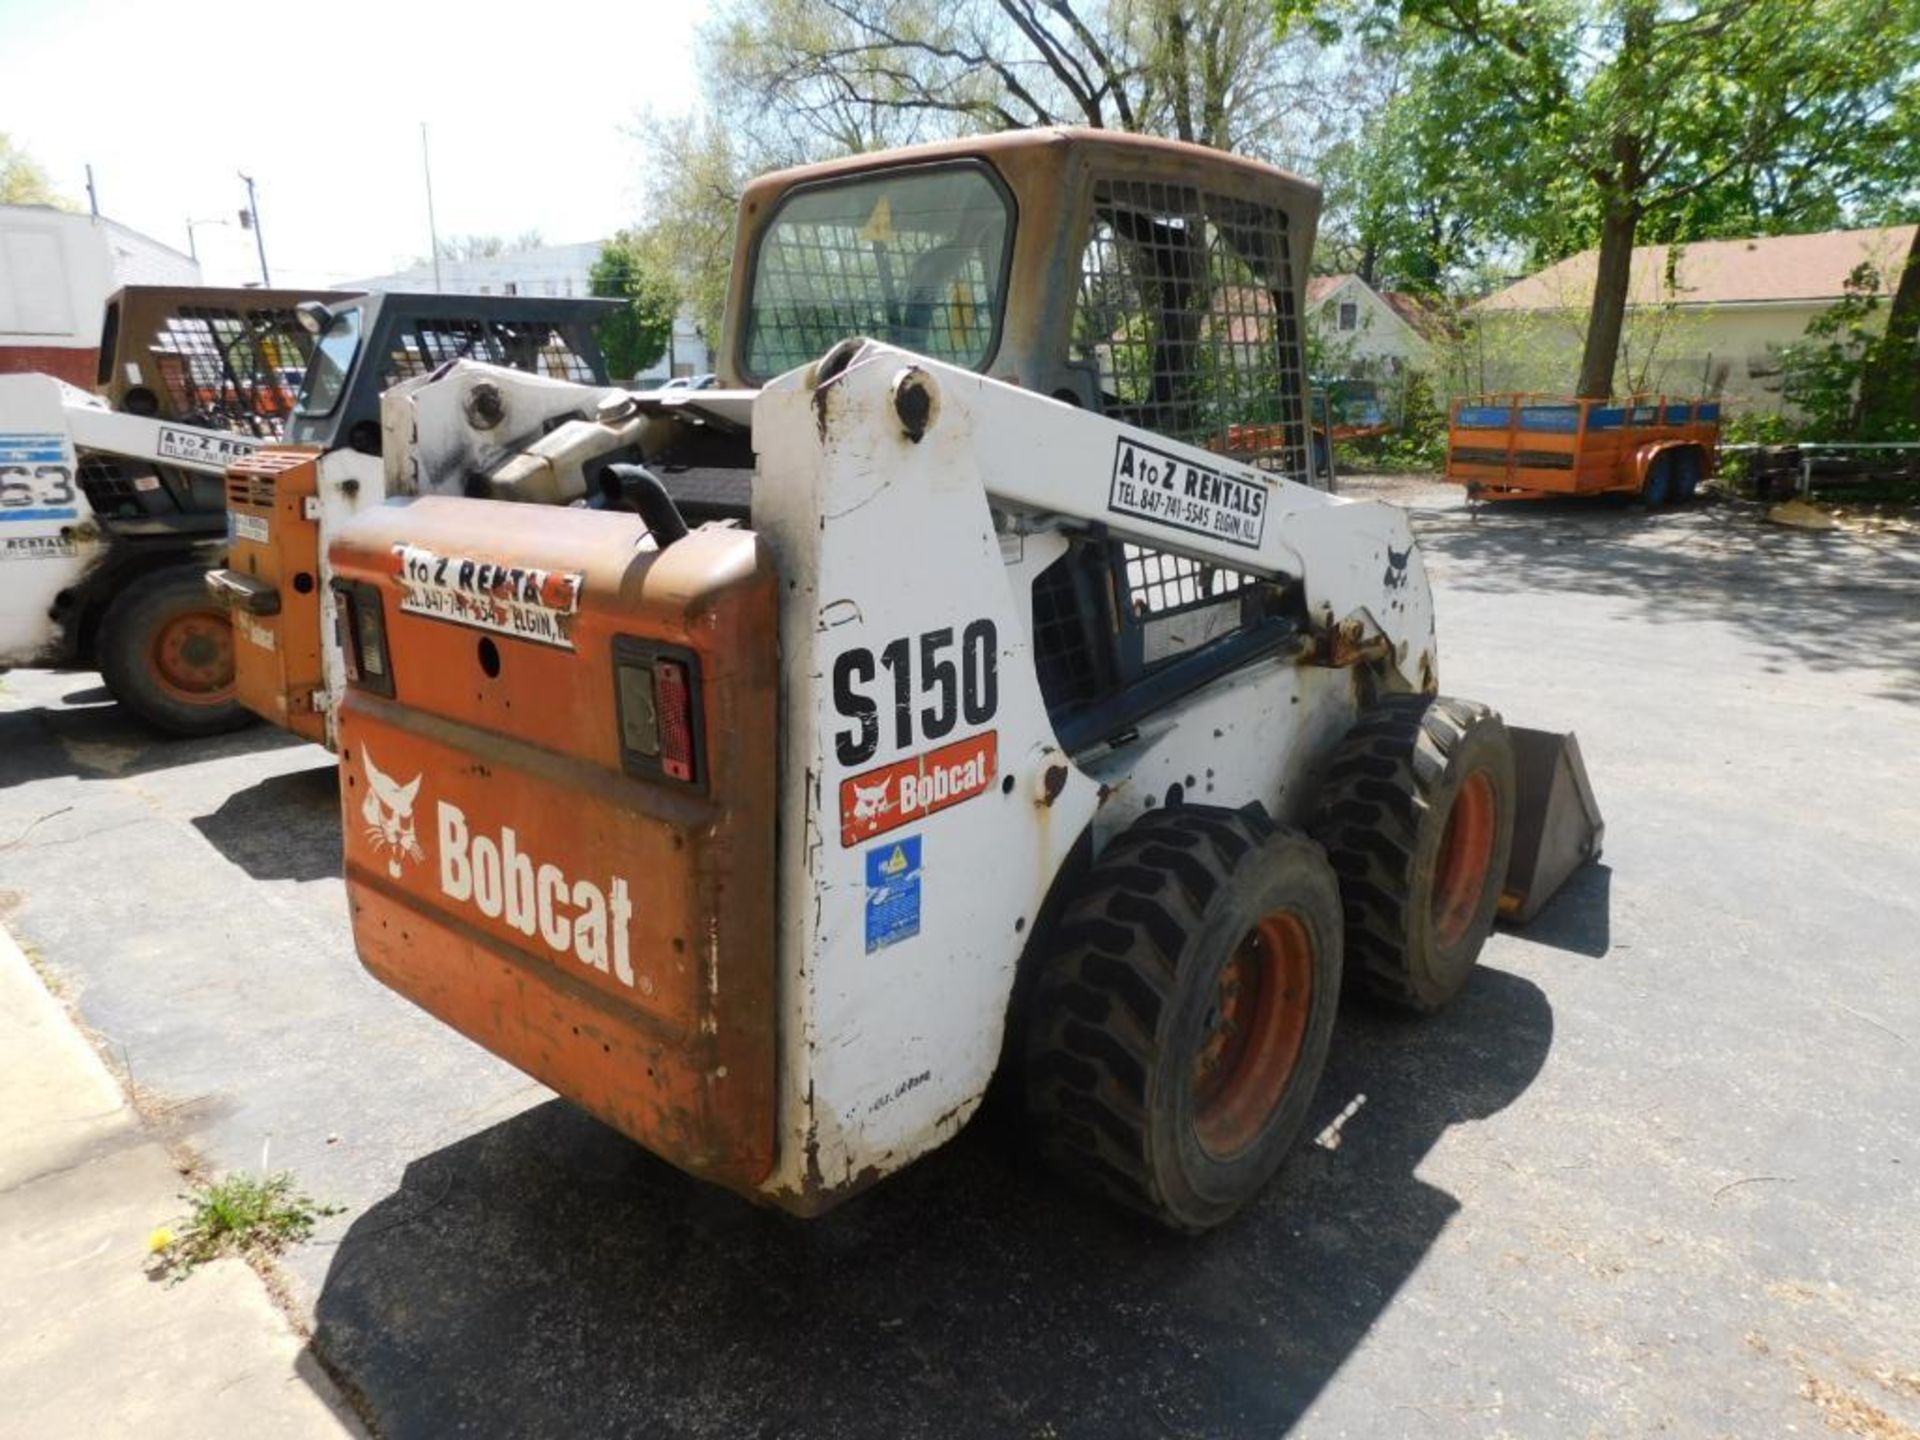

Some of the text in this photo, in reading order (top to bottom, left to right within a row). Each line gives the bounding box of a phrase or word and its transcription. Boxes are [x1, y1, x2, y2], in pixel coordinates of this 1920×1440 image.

[165, 432, 175, 442] A
[180, 436, 196, 448] to
[199, 437, 210, 450] Z
[1118, 481, 1139, 507] TEL.
[1120, 447, 1262, 517] A to Z RENTALS
[408, 557, 428, 583] to
[433, 558, 449, 585] Z
[833, 618, 998, 767] S150
[901, 750, 986, 815] Bobcat
[438, 800, 634, 988] Bobcat
